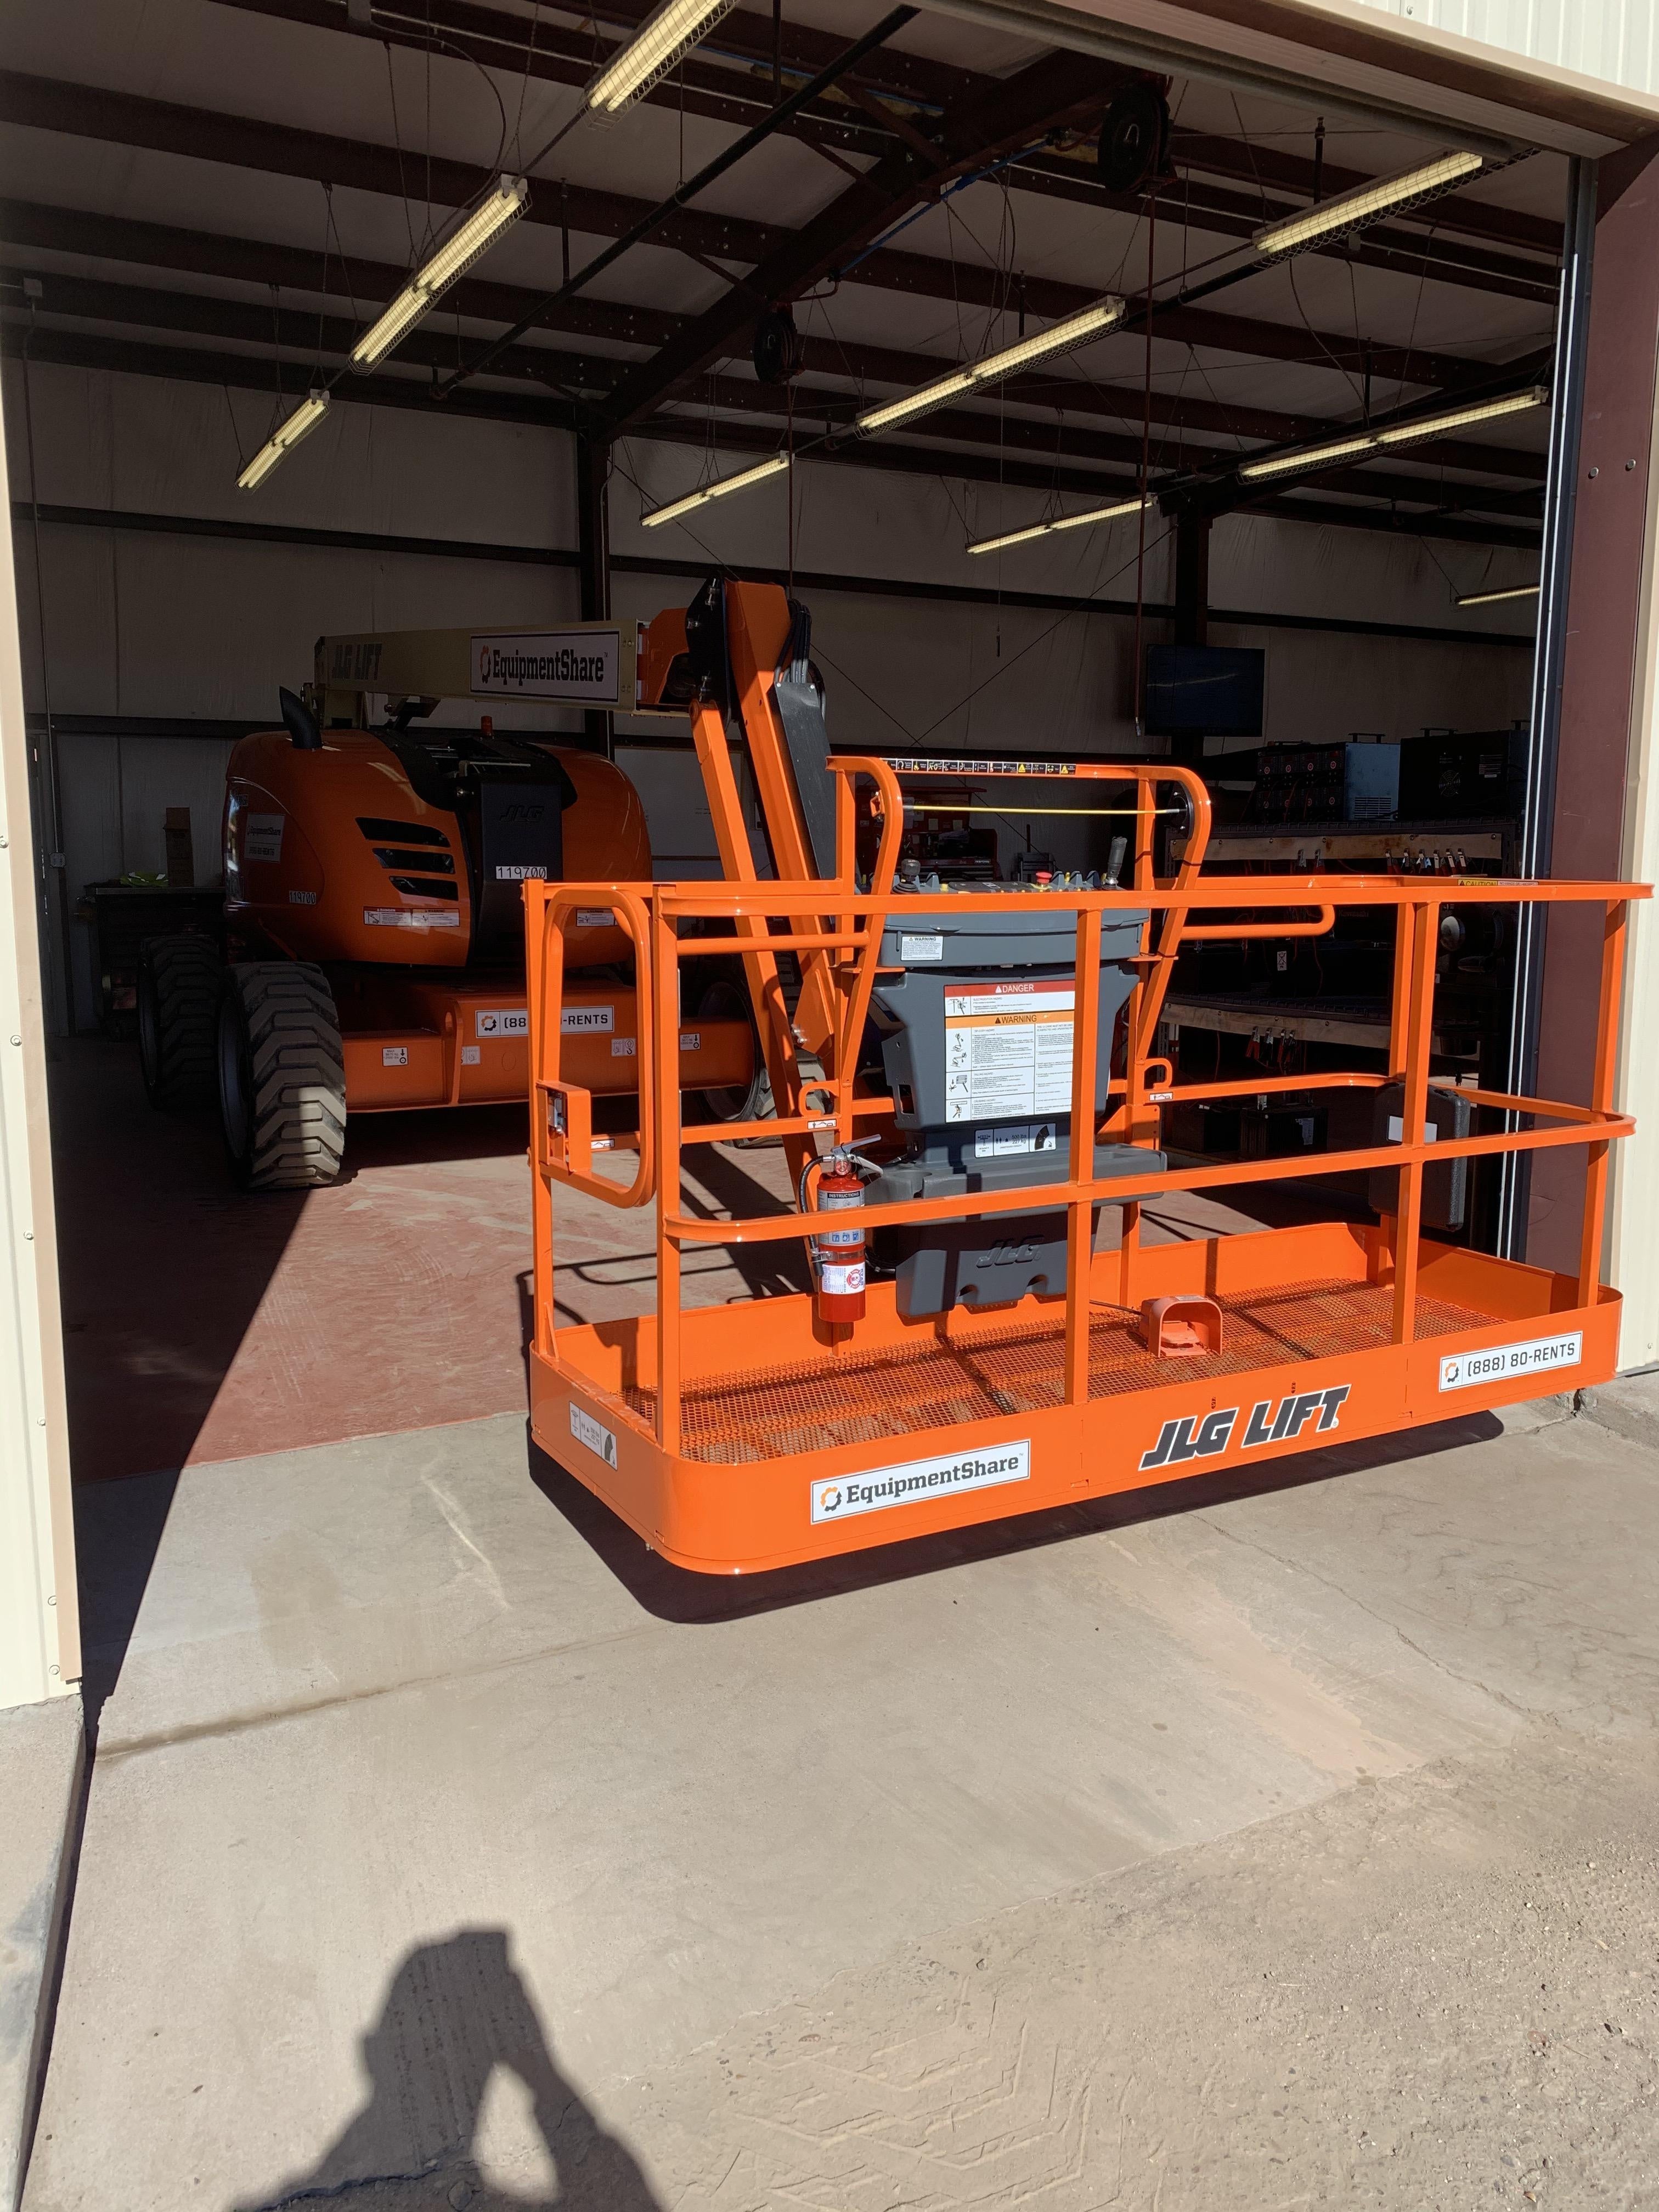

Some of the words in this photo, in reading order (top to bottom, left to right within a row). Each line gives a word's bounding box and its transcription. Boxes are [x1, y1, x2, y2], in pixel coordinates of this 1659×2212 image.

[354, 643, 382, 680] LIFT
[493, 649, 605, 686] EquipmentShare
[500, 805, 544, 822] JLG
[498, 867, 546, 878] 119700
[290, 892, 316, 904] 119700
[1002, 984, 1034, 993] DANGER
[1001, 1014, 1037, 1024] WARNING
[976, 1234, 1043, 1268] JLG
[1468, 1355, 1505, 1376] (888)
[1510, 1342, 1575, 1367] 80-RENTS
[1138, 1407, 1239, 1471] JLG
[1240, 1384, 1352, 1449] LIFT
[847, 1456, 1019, 1504] EquipmentShare
